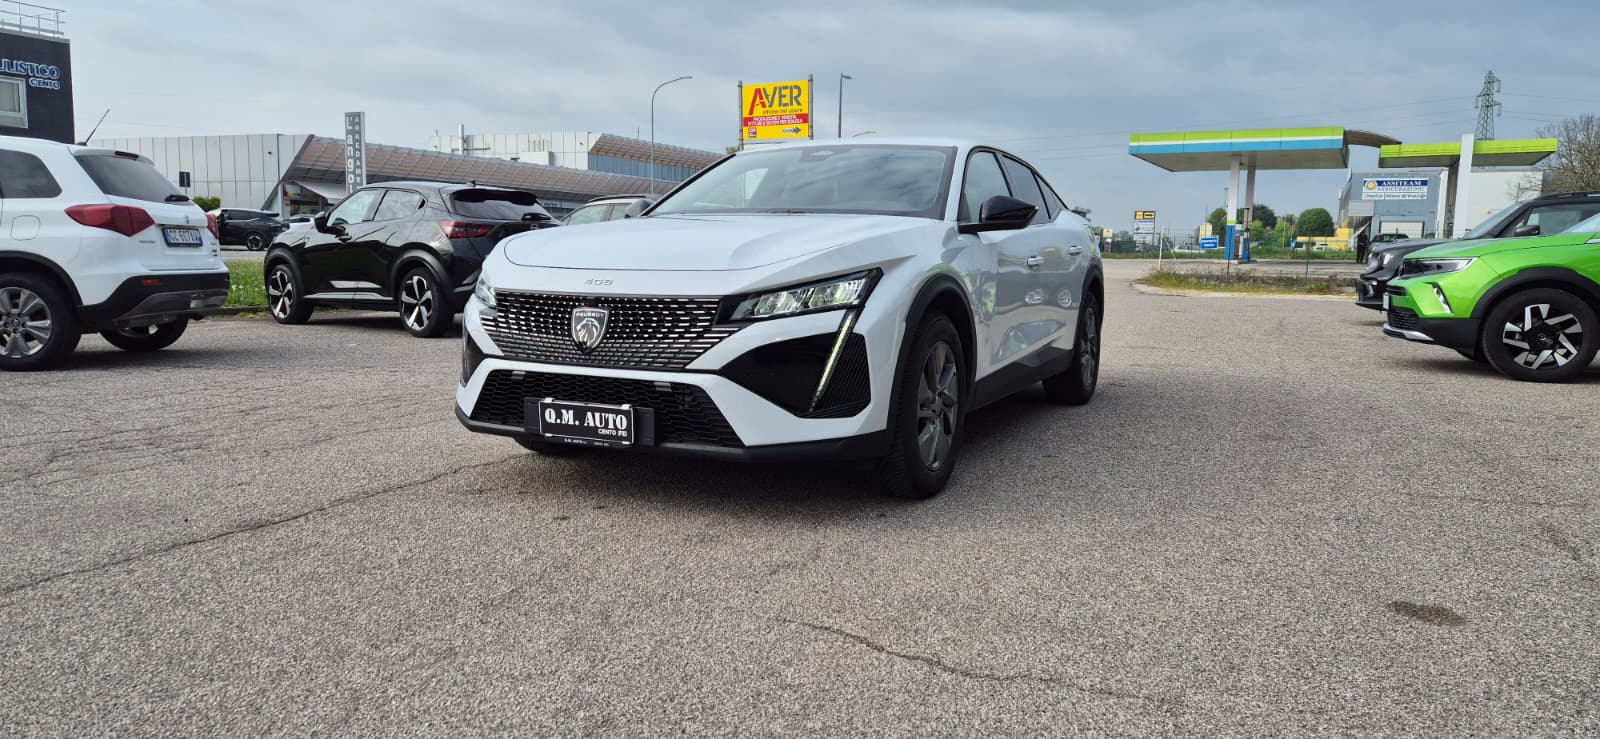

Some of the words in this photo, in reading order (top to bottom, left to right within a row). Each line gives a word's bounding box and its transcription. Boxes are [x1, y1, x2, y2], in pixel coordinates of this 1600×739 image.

[748, 85, 803, 115] AVER
[585, 278, 614, 286] 408
[544, 407, 580, 426] Q.M.
[583, 411, 628, 430] AUTO
[598, 428, 617, 436] CENTO
